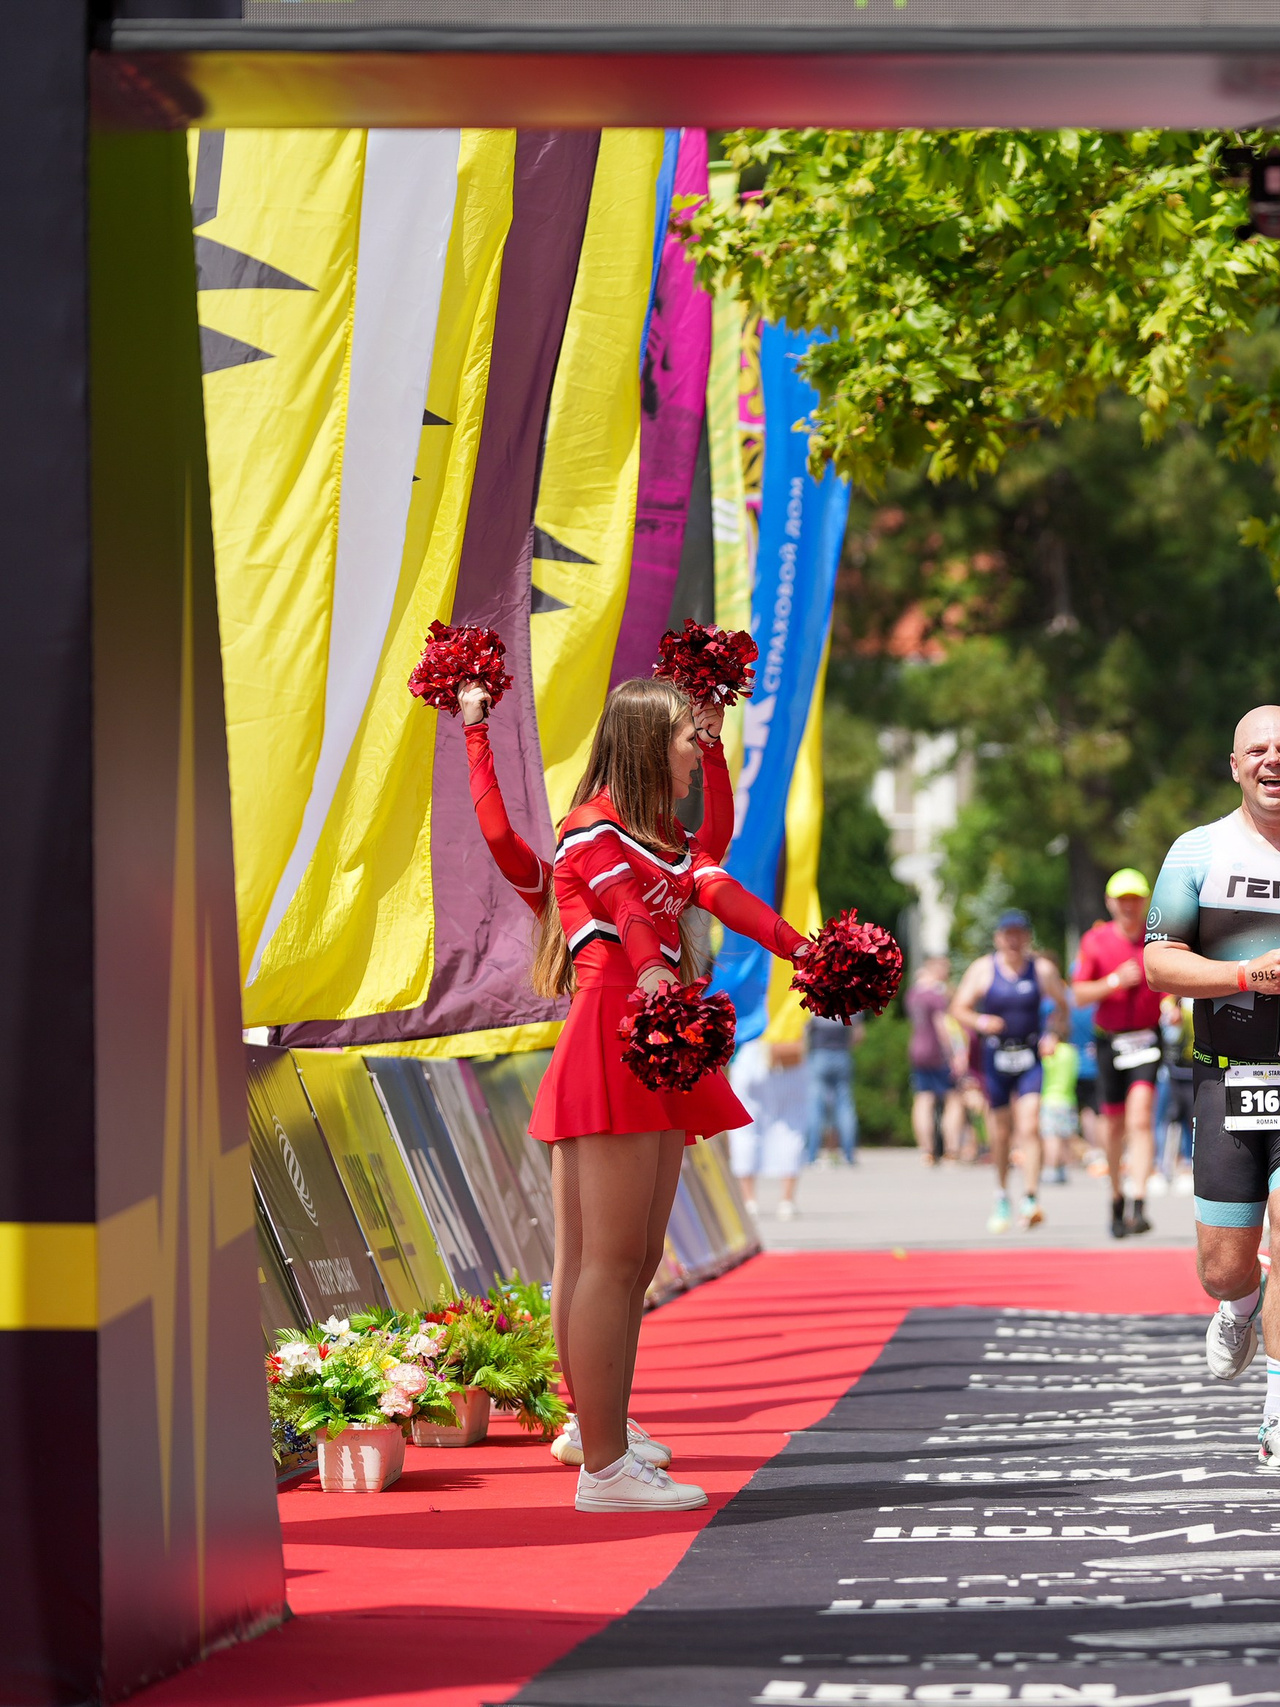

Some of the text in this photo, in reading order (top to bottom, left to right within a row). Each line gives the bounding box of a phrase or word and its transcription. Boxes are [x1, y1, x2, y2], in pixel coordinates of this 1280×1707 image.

[763, 542, 797, 693] СТРАХОВОЙ
[785, 476, 804, 540] ДОМ
[904, 1469, 1131, 1481] IRON
[873, 1526, 1130, 1538] IRON
[829, 1596, 1125, 1610] IRON
[762, 1680, 1117, 1699] IRON
